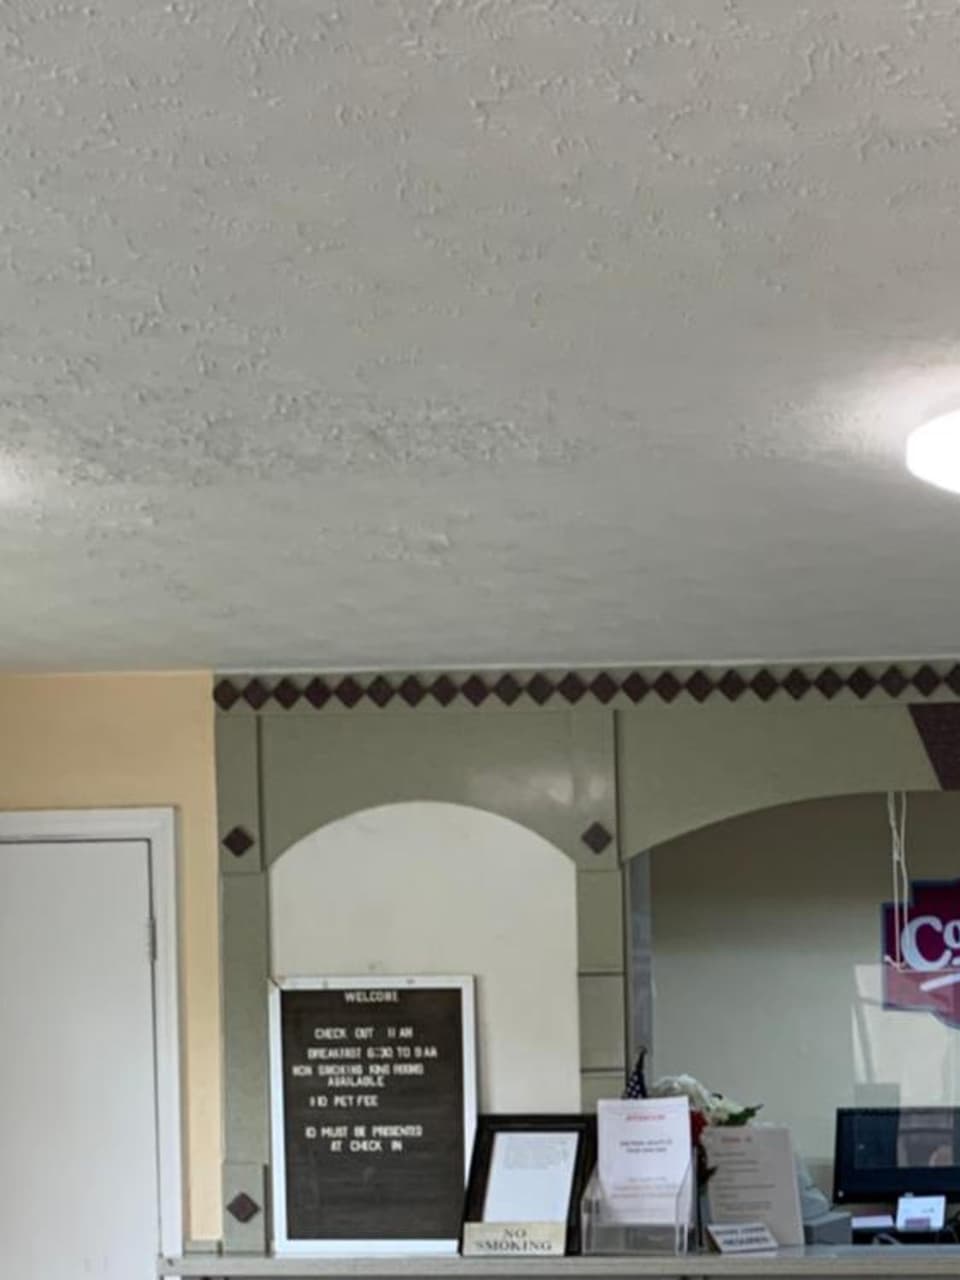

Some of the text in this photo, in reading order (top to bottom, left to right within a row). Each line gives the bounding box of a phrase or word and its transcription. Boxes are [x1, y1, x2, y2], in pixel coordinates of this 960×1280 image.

[314, 1027, 347, 1039] CHECK
[354, 1027, 374, 1039] OUT
[399, 1026, 414, 1038] AM
[397, 1047, 411, 1058] TO
[318, 1064, 363, 1076] SMOKING
[350, 1141, 383, 1152] CHECK
[503, 1228, 527, 1238] NO
[475, 1241, 552, 1251] SMOKING
